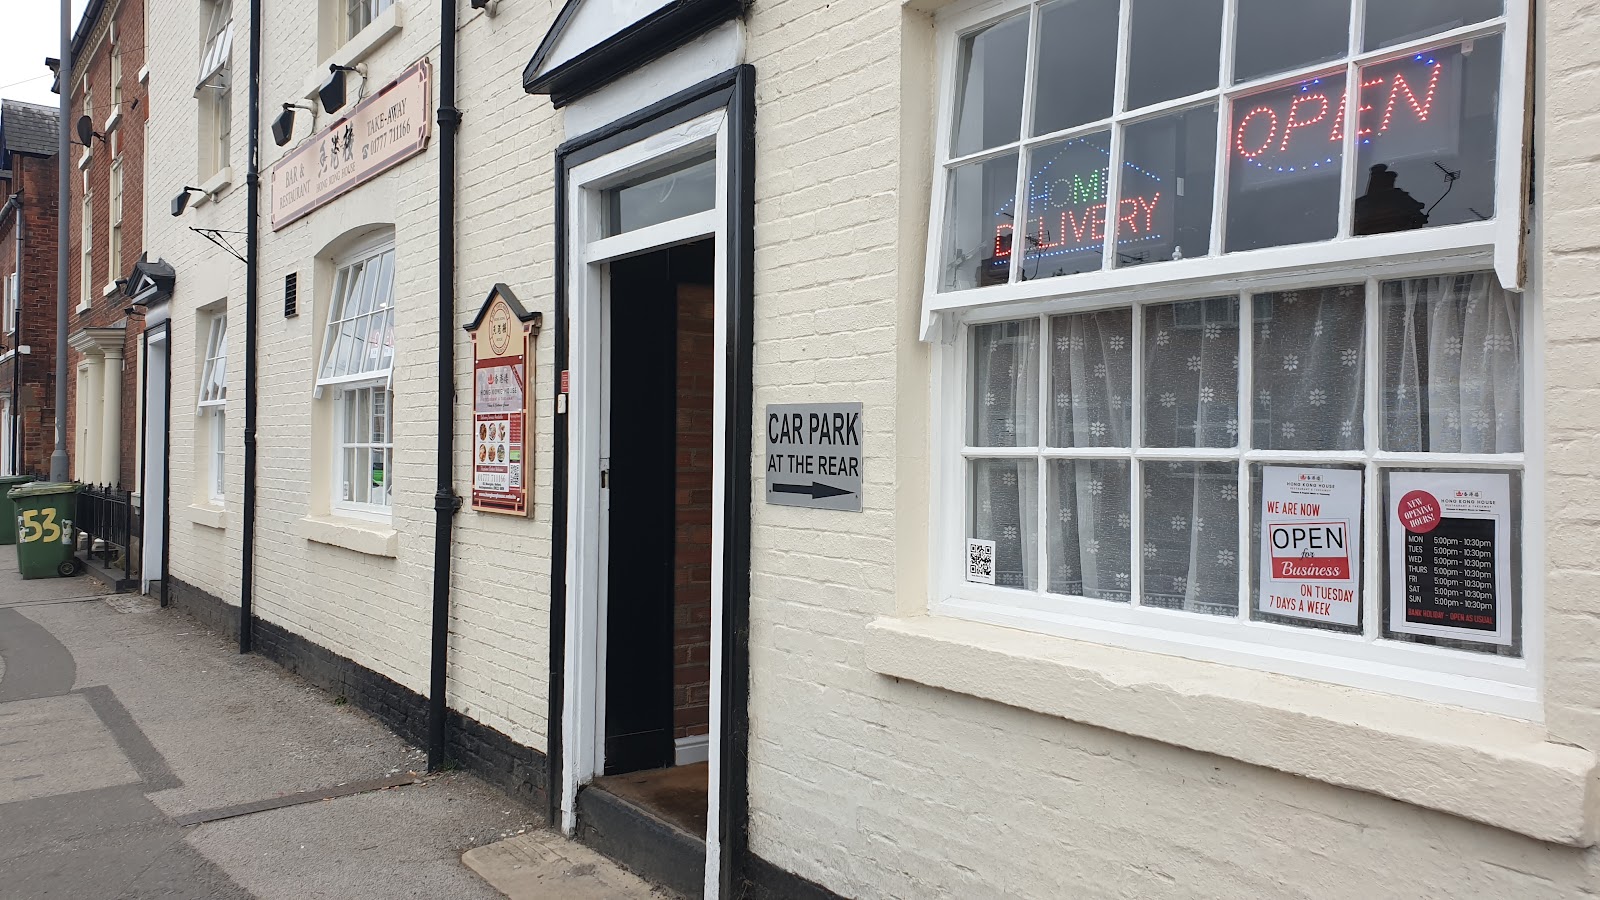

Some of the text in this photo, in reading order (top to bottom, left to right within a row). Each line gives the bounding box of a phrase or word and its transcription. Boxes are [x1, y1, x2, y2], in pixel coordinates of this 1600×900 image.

[366, 98, 407, 137] TAKE-AWAY
[1236, 62, 1442, 157] OPEN
[370, 118, 411, 156] 01777 711166
[285, 163, 305, 188] BAR &
[316, 162, 356, 193] HONG KONG HOUSE
[280, 180, 311, 209] RESTAURANT
[769, 412, 859, 445] CAR PARK
[768, 454, 859, 476] AT THE REAR
[1267, 501, 1320, 516] WE ARE NOW
[1404, 505, 1434, 519] OPENING
[1406, 498, 1422, 510] NEW
[23, 508, 60, 543] 53
[1409, 514, 1436, 528] HOURS!
[1273, 527, 1343, 549] OPEN
[1433, 537, 1458, 546] 5:00pm
[1464, 538, 1491, 548] 10:30pm
[1301, 548, 1315, 560] for
[1434, 547, 1458, 556] 5:00pm
[1464, 549, 1491, 558] 10:30pm
[1281, 561, 1342, 577] Business
[1434, 557, 1458, 566] 5:00pm
[1464, 559, 1492, 568] 10:30pm
[1408, 566, 1428, 574] THURS
[1434, 567, 1459, 576] 5:00pm
[1465, 569, 1492, 579] 10:30pm
[1434, 577, 1459, 586] 5:00pm
[1465, 579, 1492, 589] 10:30pm
[1301, 584, 1354, 603] ON TUESDAY
[1434, 587, 1459, 597] 5:00pm
[1465, 590, 1492, 599] 10:30pm
[1269, 595, 1331, 616] 7 DAYS A WEEK
[1434, 597, 1459, 607] 5:00pm
[1465, 600, 1492, 610] 10:30pm
[1408, 608, 1422, 617] BANK
[1423, 610, 1444, 619] HOLIDAY
[1450, 613, 1464, 621] OPEN
[1474, 615, 1493, 624] USUAL
